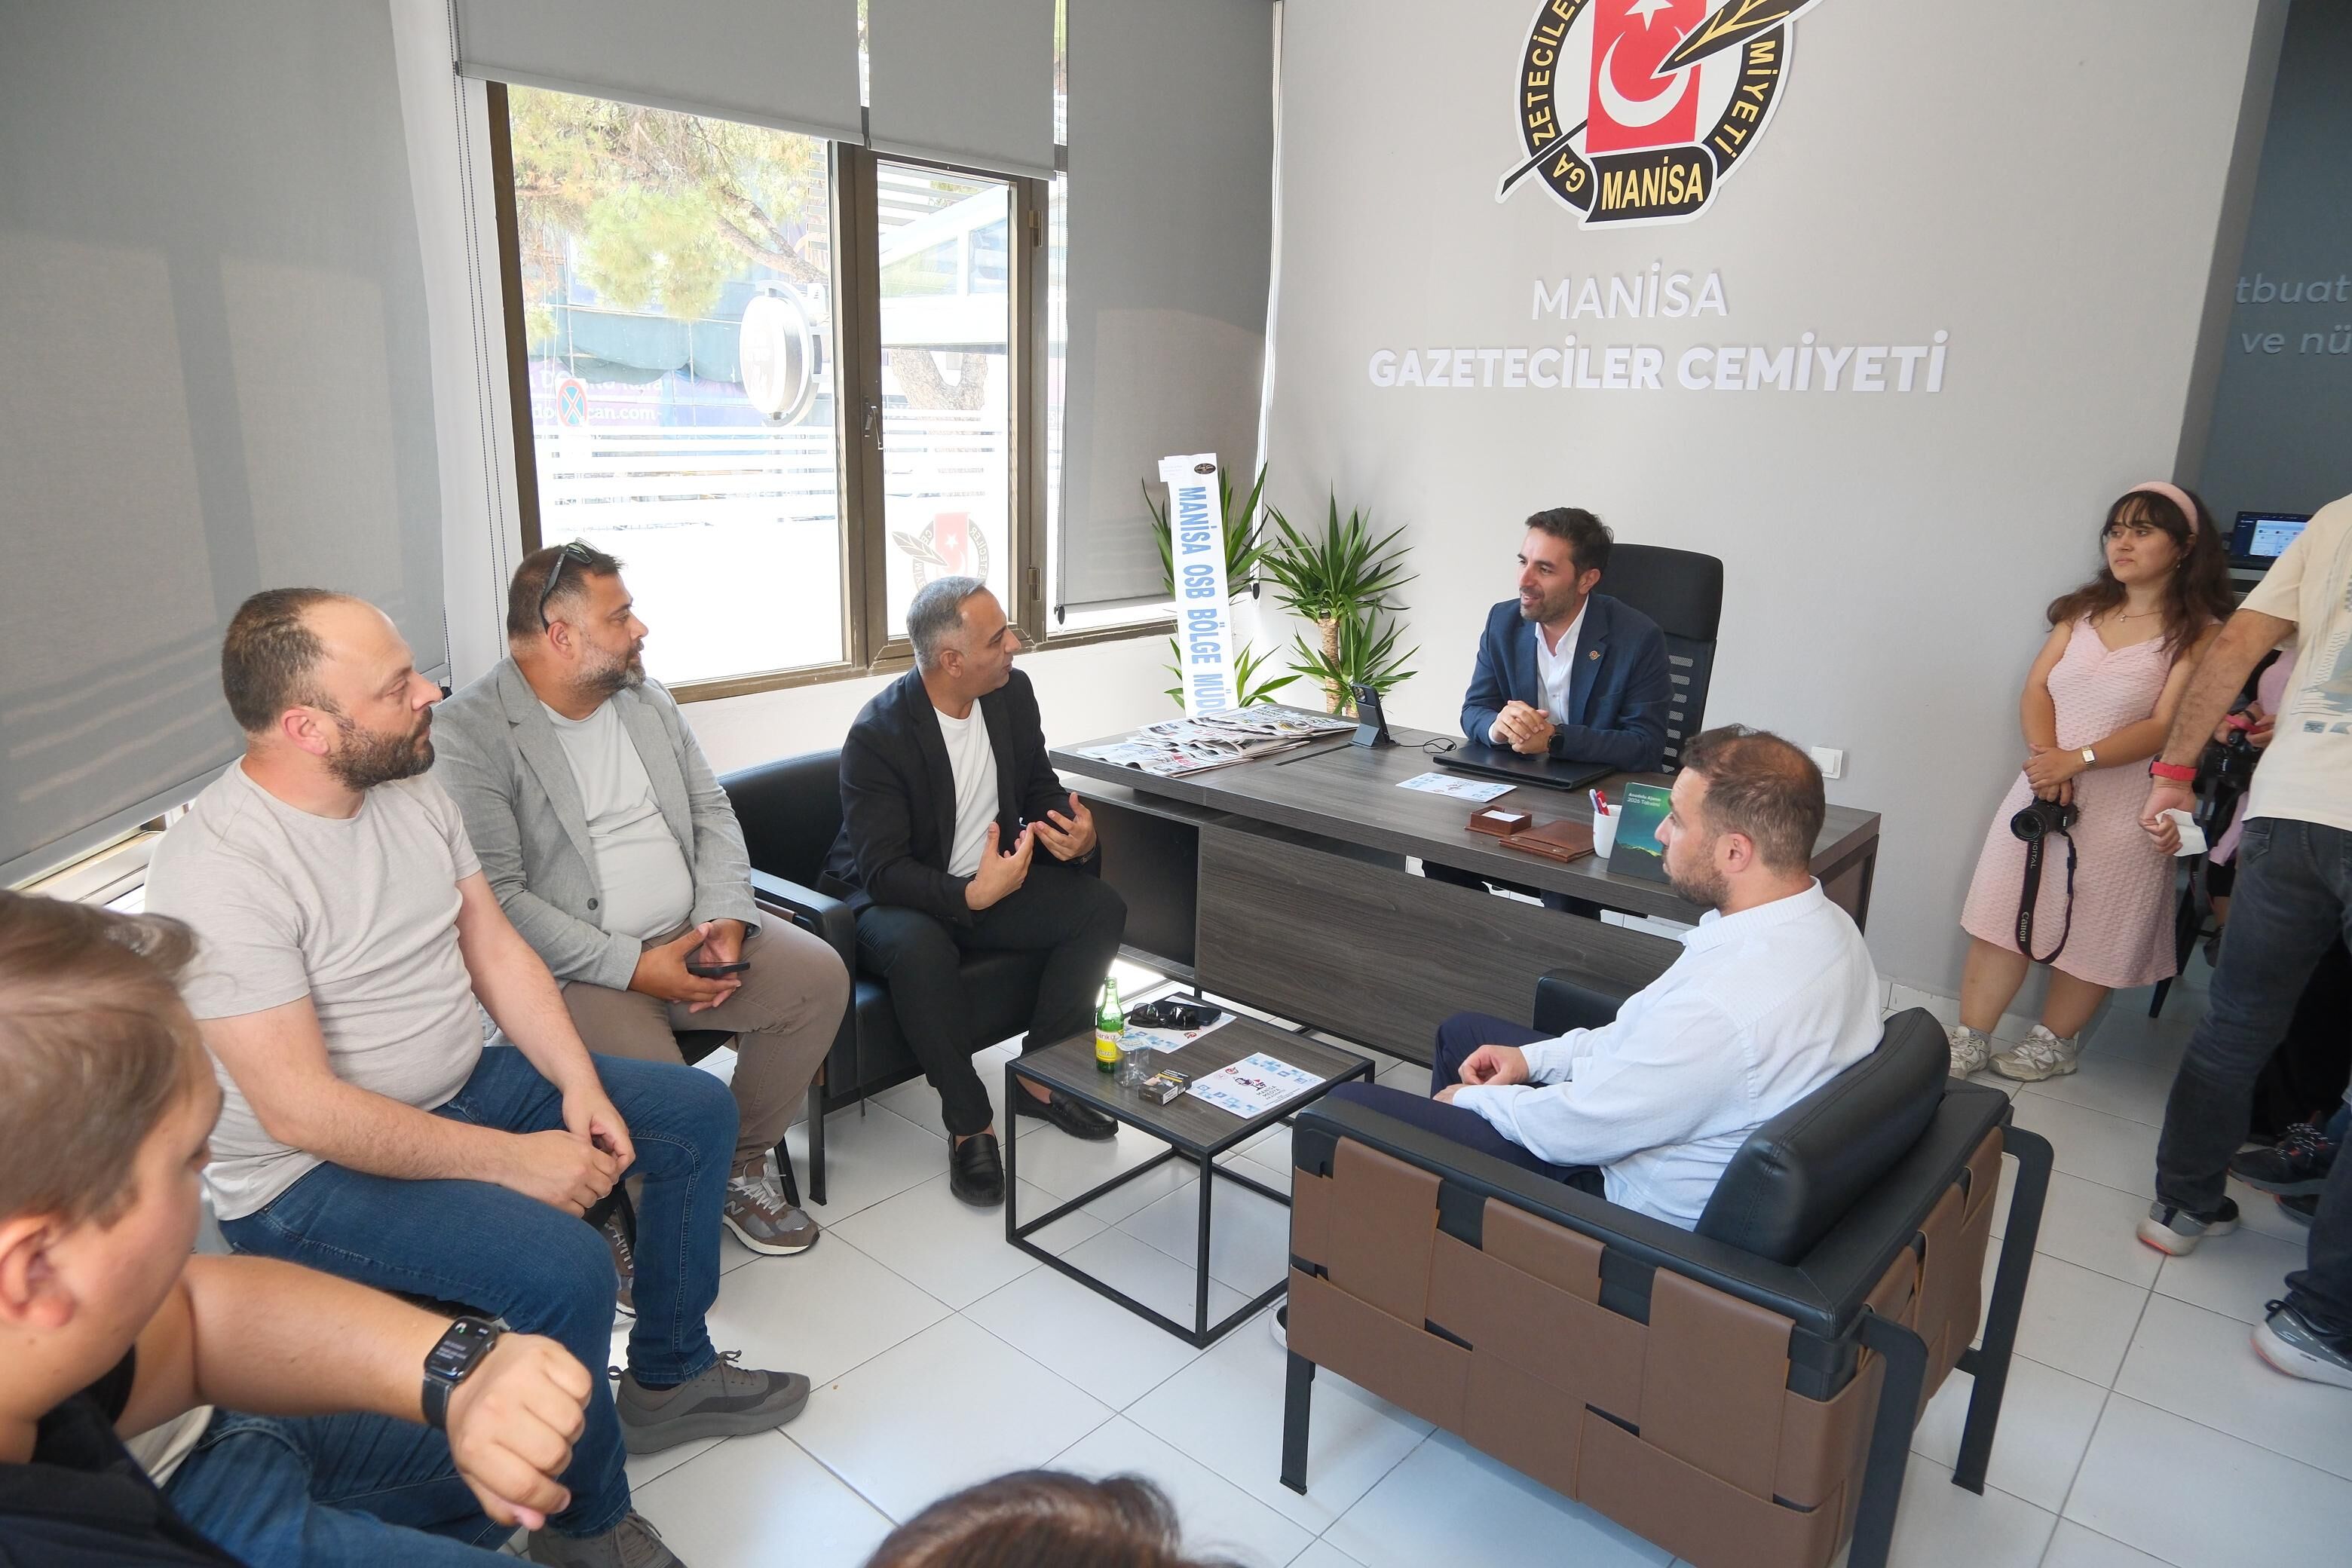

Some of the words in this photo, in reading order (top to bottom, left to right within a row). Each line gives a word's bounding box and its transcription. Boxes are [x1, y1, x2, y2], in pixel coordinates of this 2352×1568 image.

[1527, 0, 1587, 194] GAZETECİLE
[1601, 156, 1704, 211] MANİSA
[1532, 262, 1728, 320] MANİSA
[1368, 334, 1664, 390] GAZETECİLER
[1677, 329, 1949, 392] CEMİYETİ
[2241, 332, 2285, 355] ve
[1178, 486, 1217, 555] MANİSA
[1184, 564, 1215, 599] OSB
[1187, 608, 1226, 664] BÖLGE
[2020, 911, 2029, 942] Canon
